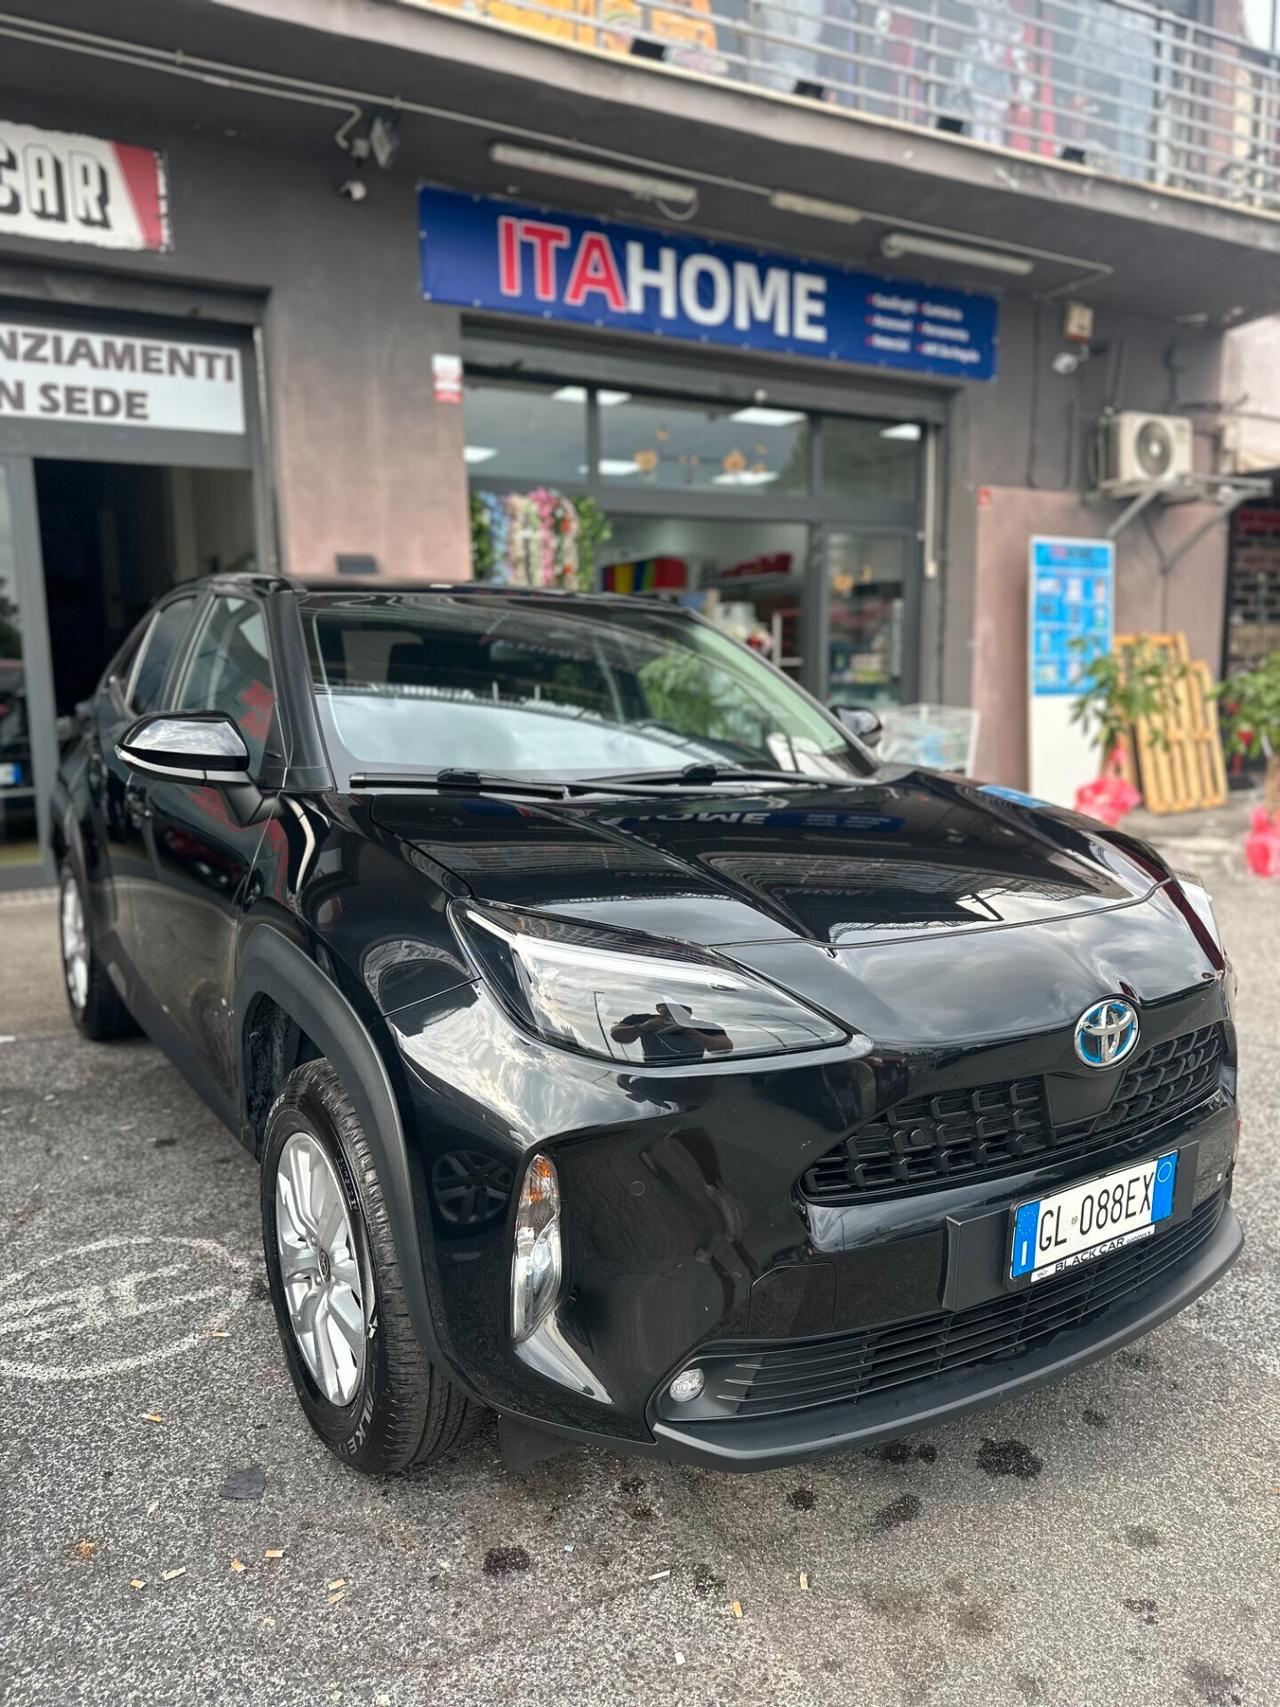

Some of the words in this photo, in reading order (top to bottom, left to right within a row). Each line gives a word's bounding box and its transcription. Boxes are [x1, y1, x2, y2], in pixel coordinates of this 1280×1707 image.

[498, 215, 828, 343] ITAHOME
[0, 329, 235, 382] NZIAMENTI
[38, 383, 150, 420] SEDE
[1039, 1205, 1067, 1251] GL
[1079, 1172, 1154, 1236] 088EX
[1055, 1248, 1098, 1272] BLACK
[1099, 1237, 1125, 1254] CAR
